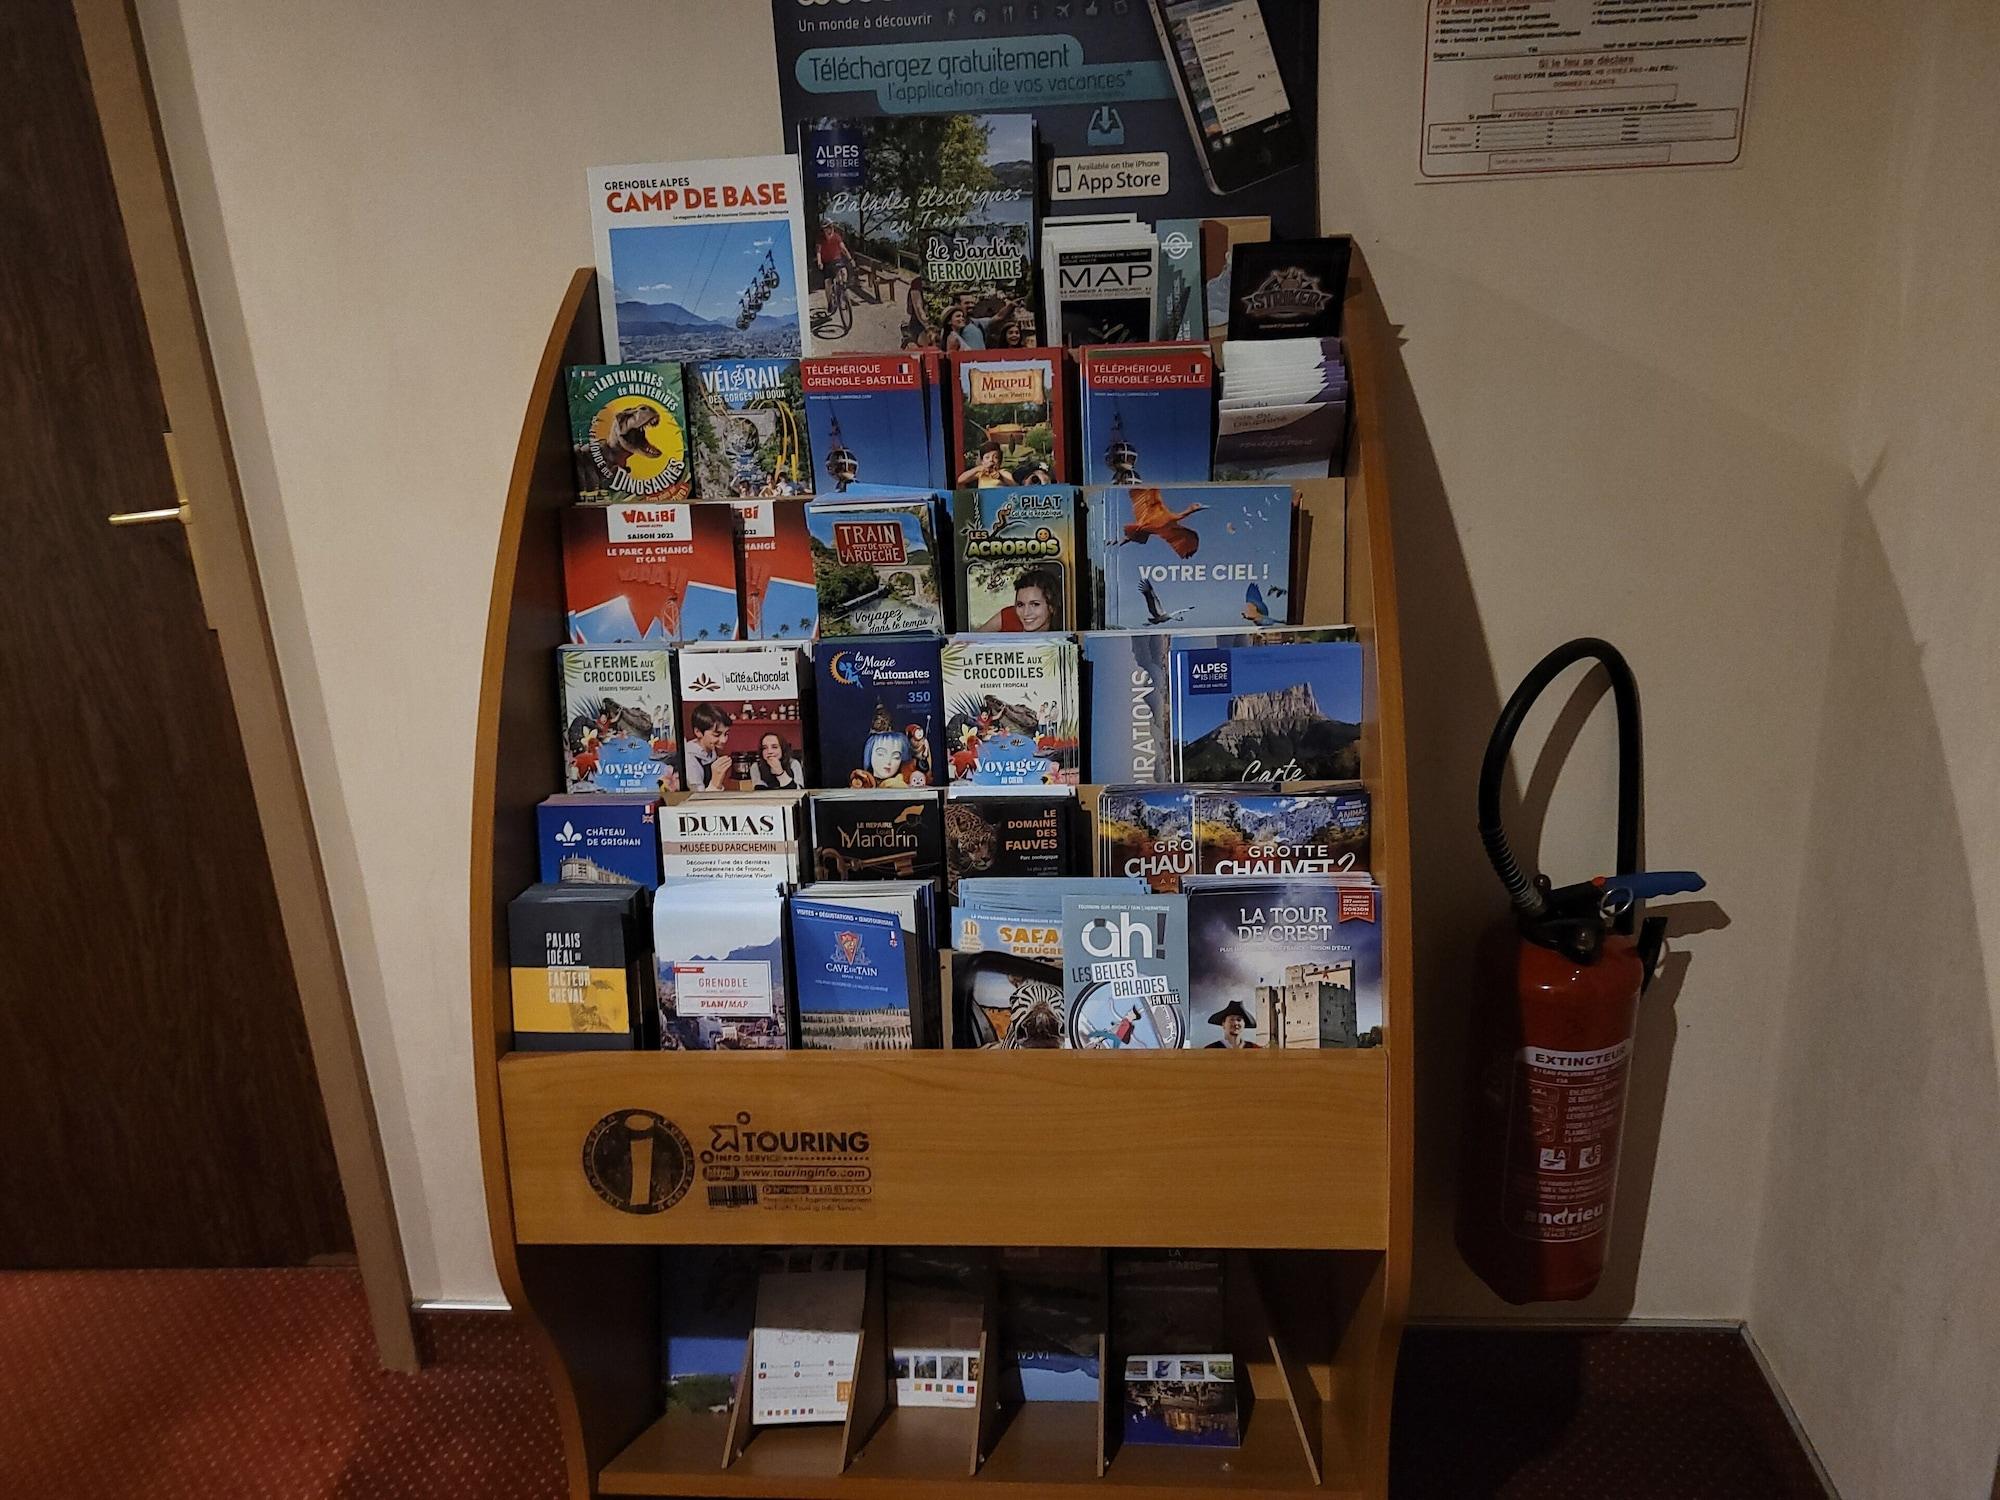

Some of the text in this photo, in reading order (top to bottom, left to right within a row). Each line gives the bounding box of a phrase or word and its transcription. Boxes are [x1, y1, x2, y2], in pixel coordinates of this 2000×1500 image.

[799, 13, 933, 33] Un monde à découvrir
[809, 44, 1069, 83] Téléchargez gratuitement
[887, 78, 986, 104] l'application
[989, 76, 1011, 95] de
[1014, 77, 1043, 94] vos
[816, 145, 860, 159] ALPES
[1135, 159, 1161, 169] iPhone
[604, 177, 690, 191] GRENOBLE ALPES
[1077, 171, 1161, 193] App Store
[606, 182, 788, 213] CAMP DE BASE
[832, 182, 1023, 214] Balades électriques
[890, 220, 914, 234] en
[926, 236, 1022, 262] Le Jardin
[928, 258, 1023, 282] FERROVIAIRE
[1059, 264, 1153, 289] MAP
[594, 369, 665, 391] LABYRINTHES
[807, 374, 914, 387] GRENOBLE-BASTILLE
[1093, 374, 1206, 385] GRENOBLE-BASTILLE
[708, 394, 723, 404] DES
[725, 391, 754, 404] GORGES
[755, 390, 765, 400] DU
[609, 457, 686, 495] DINOSAURES
[1021, 495, 1062, 508] PILAT
[838, 524, 897, 545] TRAIN
[969, 531, 989, 540] LES
[607, 544, 694, 557] LE PARC A CHANGÉ
[868, 542, 879, 550] DE
[635, 556, 645, 564] ET
[657, 555, 667, 563] SE
[1138, 564, 1207, 583] VOTRE
[1211, 563, 1258, 581] CIEL
[855, 607, 904, 627] Voyagez
[869, 621, 891, 634] dans
[892, 620, 901, 631] le
[902, 618, 929, 631] temps
[583, 655, 654, 669] LA FERME AUX
[855, 651, 897, 671] la Magie
[963, 652, 1043, 666] LA FERME AUX
[861, 667, 930, 681] des Automates
[963, 667, 1044, 680] CROCODILES
[1192, 662, 1228, 674] ALPES
[583, 671, 656, 683] CROCODILES
[730, 671, 746, 683] Cité
[753, 670, 790, 683] Chocolat
[736, 683, 781, 693] VALRHONA
[907, 691, 931, 702] 350
[596, 759, 662, 779] Voyagez
[974, 757, 1046, 777] Voyagez
[1242, 758, 1306, 784] Carte
[1043, 808, 1057, 818] LE
[678, 812, 775, 836] DUMAS
[1007, 818, 1058, 829] DOMAINE
[585, 826, 627, 837] CHÂTEAU
[836, 825, 919, 849] Mandrin
[1036, 828, 1058, 838] DES
[586, 838, 641, 847] DE GRIGNAN
[680, 842, 777, 853] MUSÉE DU PARCHEMIN
[1005, 838, 1059, 852] FAUVES
[1248, 844, 1330, 858] GROTTE
[1337, 852, 1356, 873] 2
[1240, 906, 1328, 924] LA TOUR
[545, 932, 581, 949] PALAIS
[1081, 911, 1167, 960] ah!
[1237, 925, 1333, 942] DE CREST
[546, 947, 576, 966] IDÉAL
[825, 962, 850, 974] CAVE
[856, 965, 878, 977] TAIN
[1072, 962, 1135, 984] LES BELLES
[548, 971, 591, 987] FACTEUR
[698, 978, 749, 989] GRENOBLE
[549, 987, 585, 1004] CHEVAL
[1152, 993, 1180, 1005] EN VILLE
[700, 1000, 749, 1009] PLAN/MAP
[742, 1131, 870, 1153] TOURING
[715, 1154, 741, 1162] INFO
[1556, 1149, 1566, 1159] A
[742, 1168, 865, 1179] www.touringinfo.com
